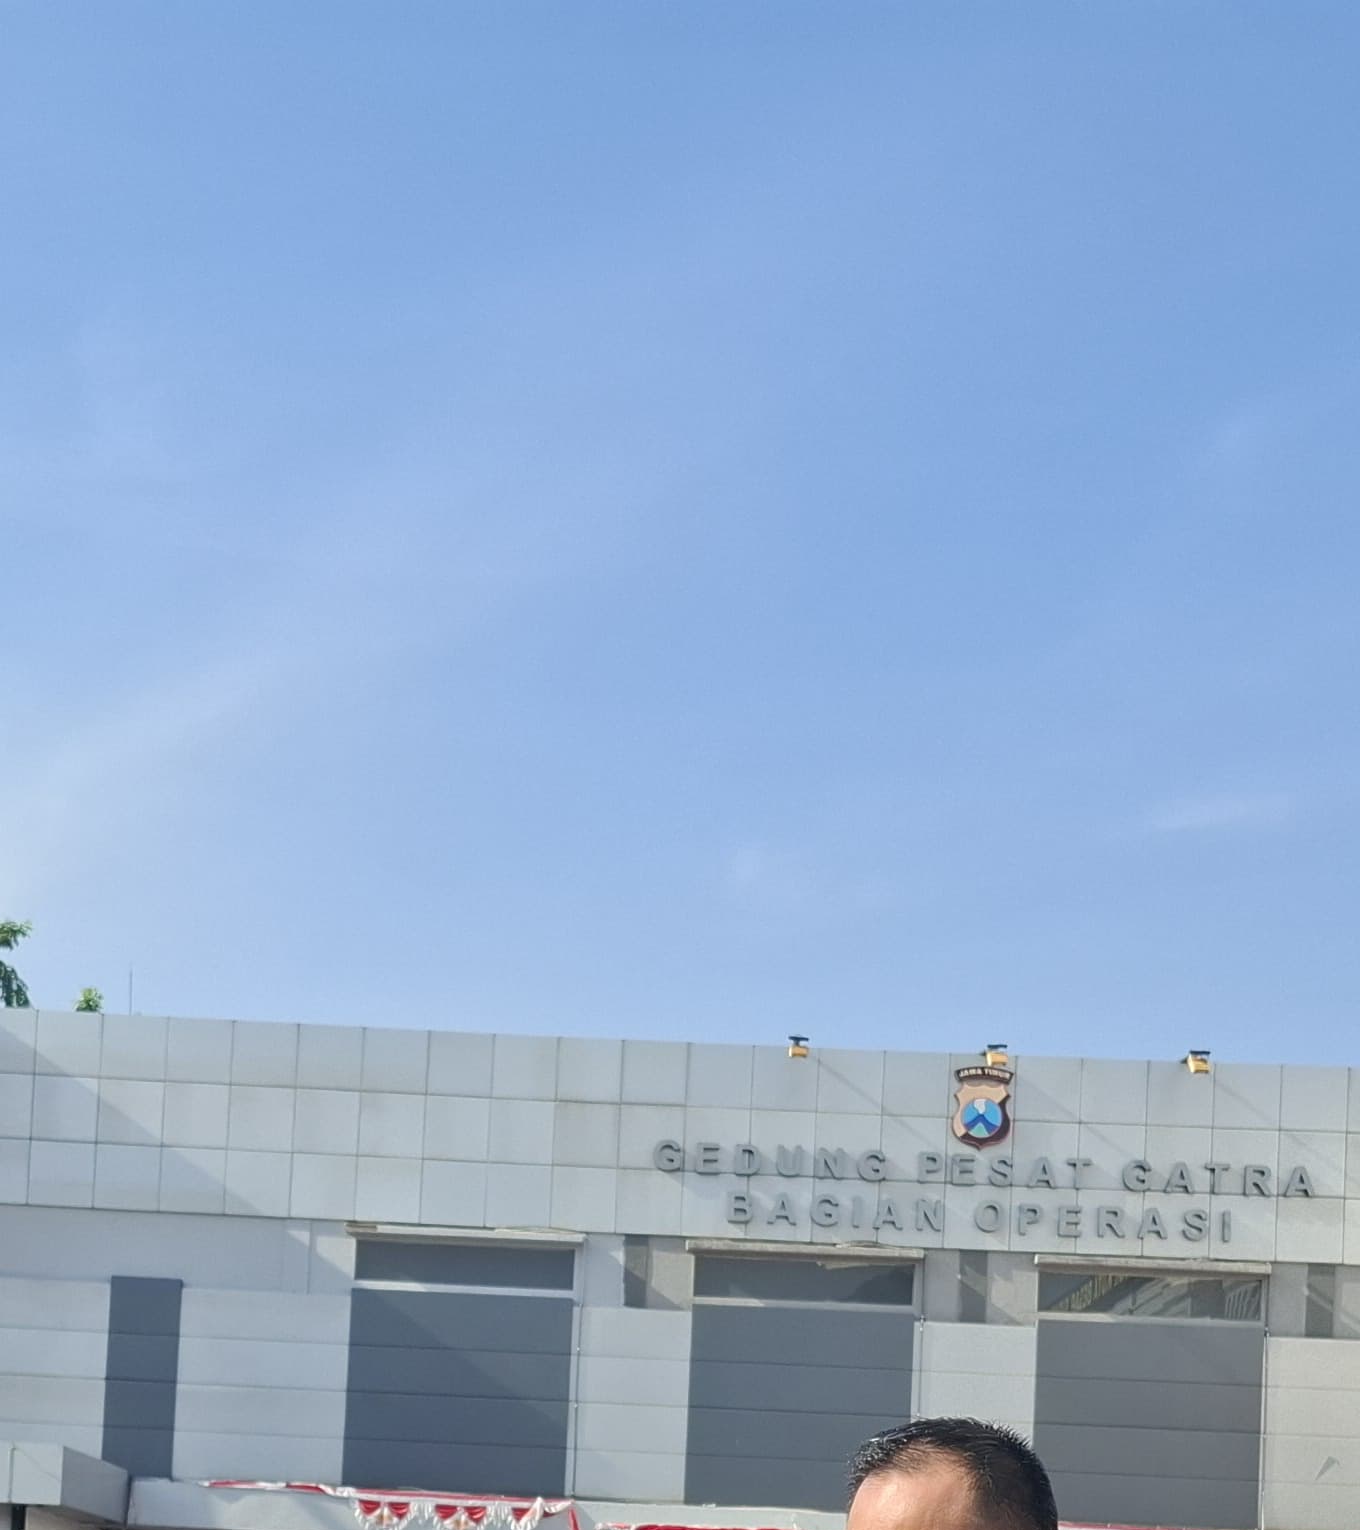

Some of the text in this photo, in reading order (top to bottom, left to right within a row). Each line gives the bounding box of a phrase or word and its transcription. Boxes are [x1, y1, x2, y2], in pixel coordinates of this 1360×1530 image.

[652, 1137, 1316, 1199] GEDUNG PESAT GATRA
[727, 1193, 1233, 1244] BAGIAN OPERASI
